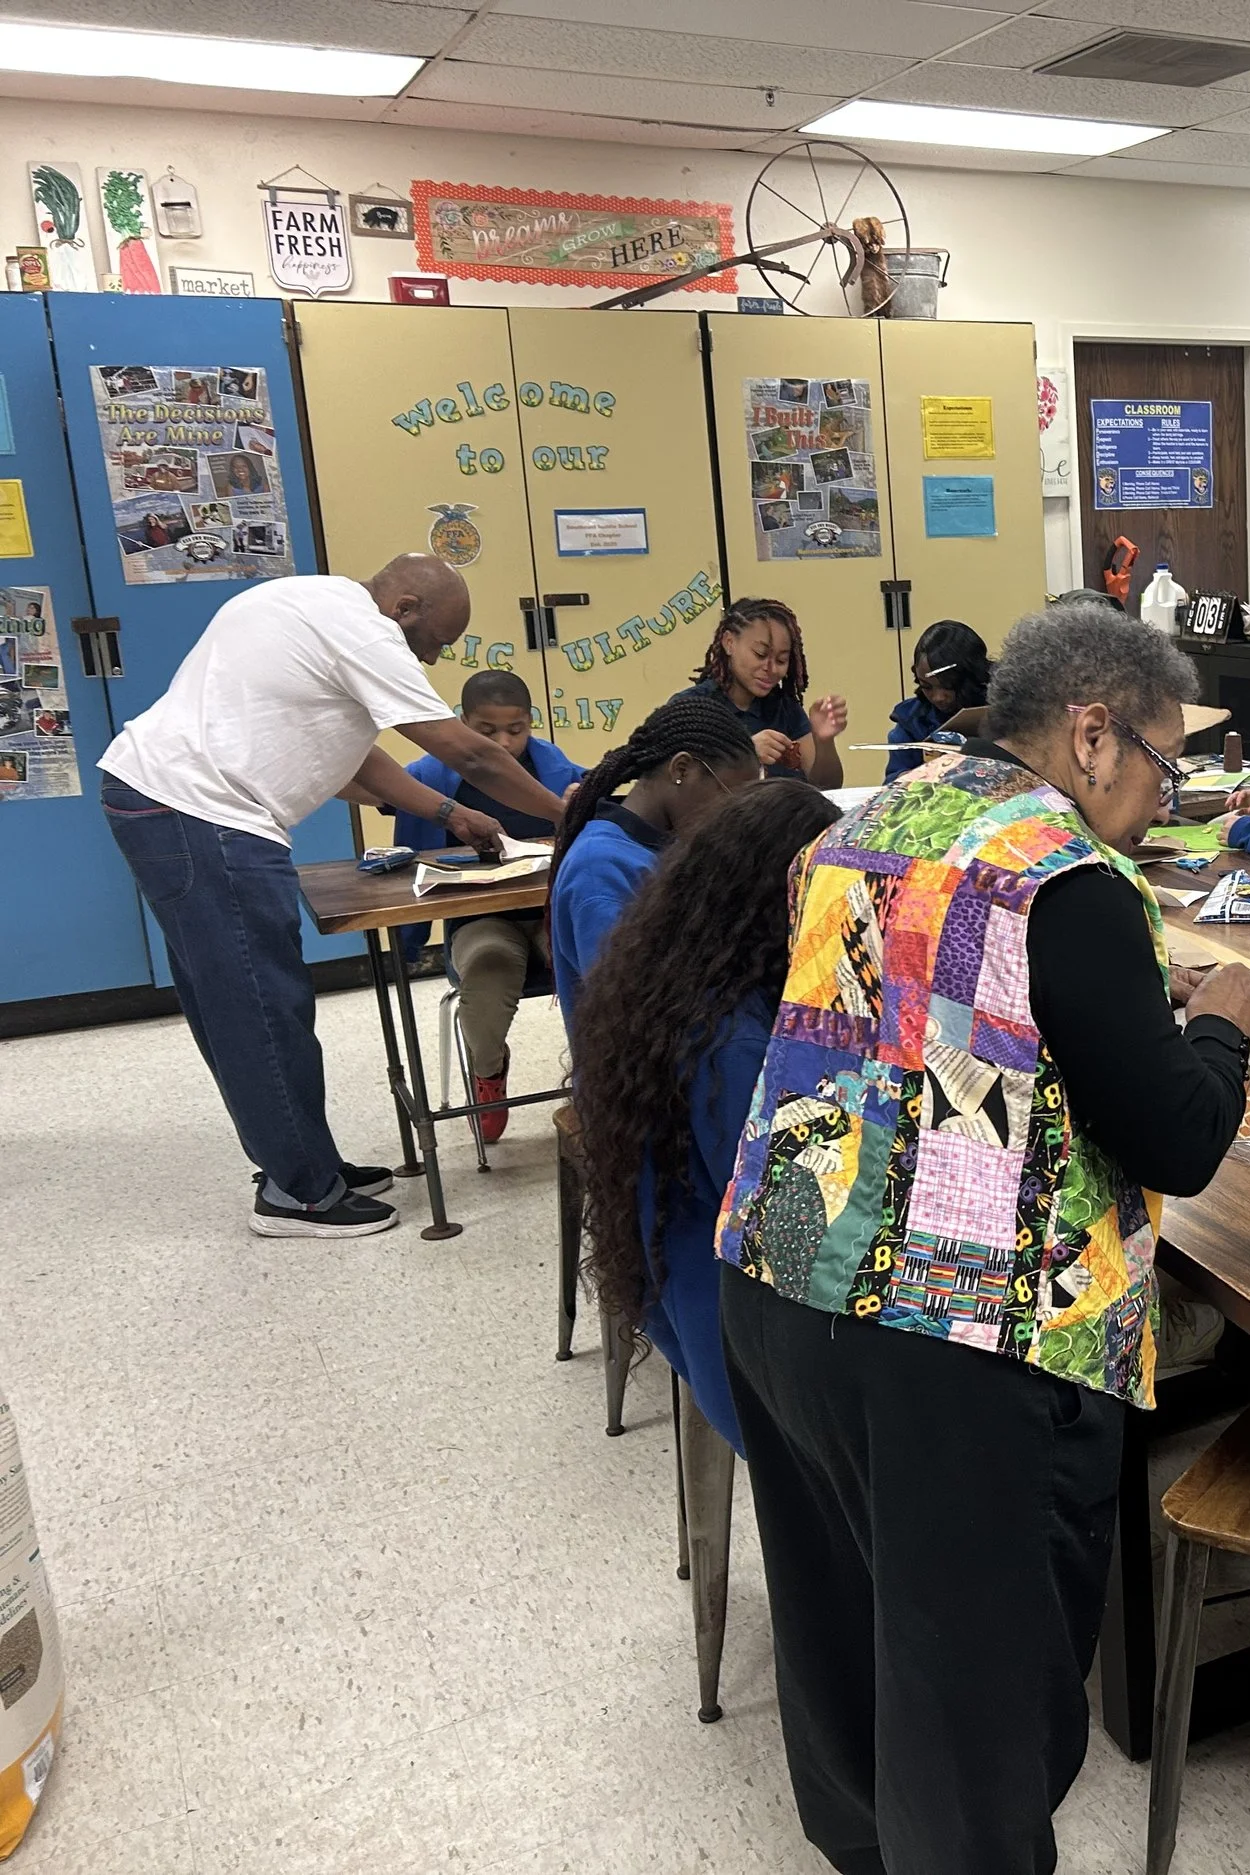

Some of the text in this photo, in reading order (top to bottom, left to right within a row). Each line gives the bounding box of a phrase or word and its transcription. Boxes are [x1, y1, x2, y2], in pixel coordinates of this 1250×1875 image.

[271, 210, 340, 234] FARM
[274, 234, 344, 258] FRESH
[562, 222, 618, 253] GROW
[608, 225, 686, 269] HERE
[282, 255, 341, 275] happiness
[181, 276, 252, 297] market
[104, 403, 266, 425] The Decisions
[753, 405, 815, 428] I Built
[1125, 405, 1181, 415] CLASSROOM
[1097, 418, 1144, 427] EXPECTATIONS
[1161, 418, 1180, 427] RULES
[116, 425, 224, 447] Are Mine
[786, 430, 827, 449] This
[456, 443, 610, 476] to our
[1187, 600, 1196, 627] TUE
